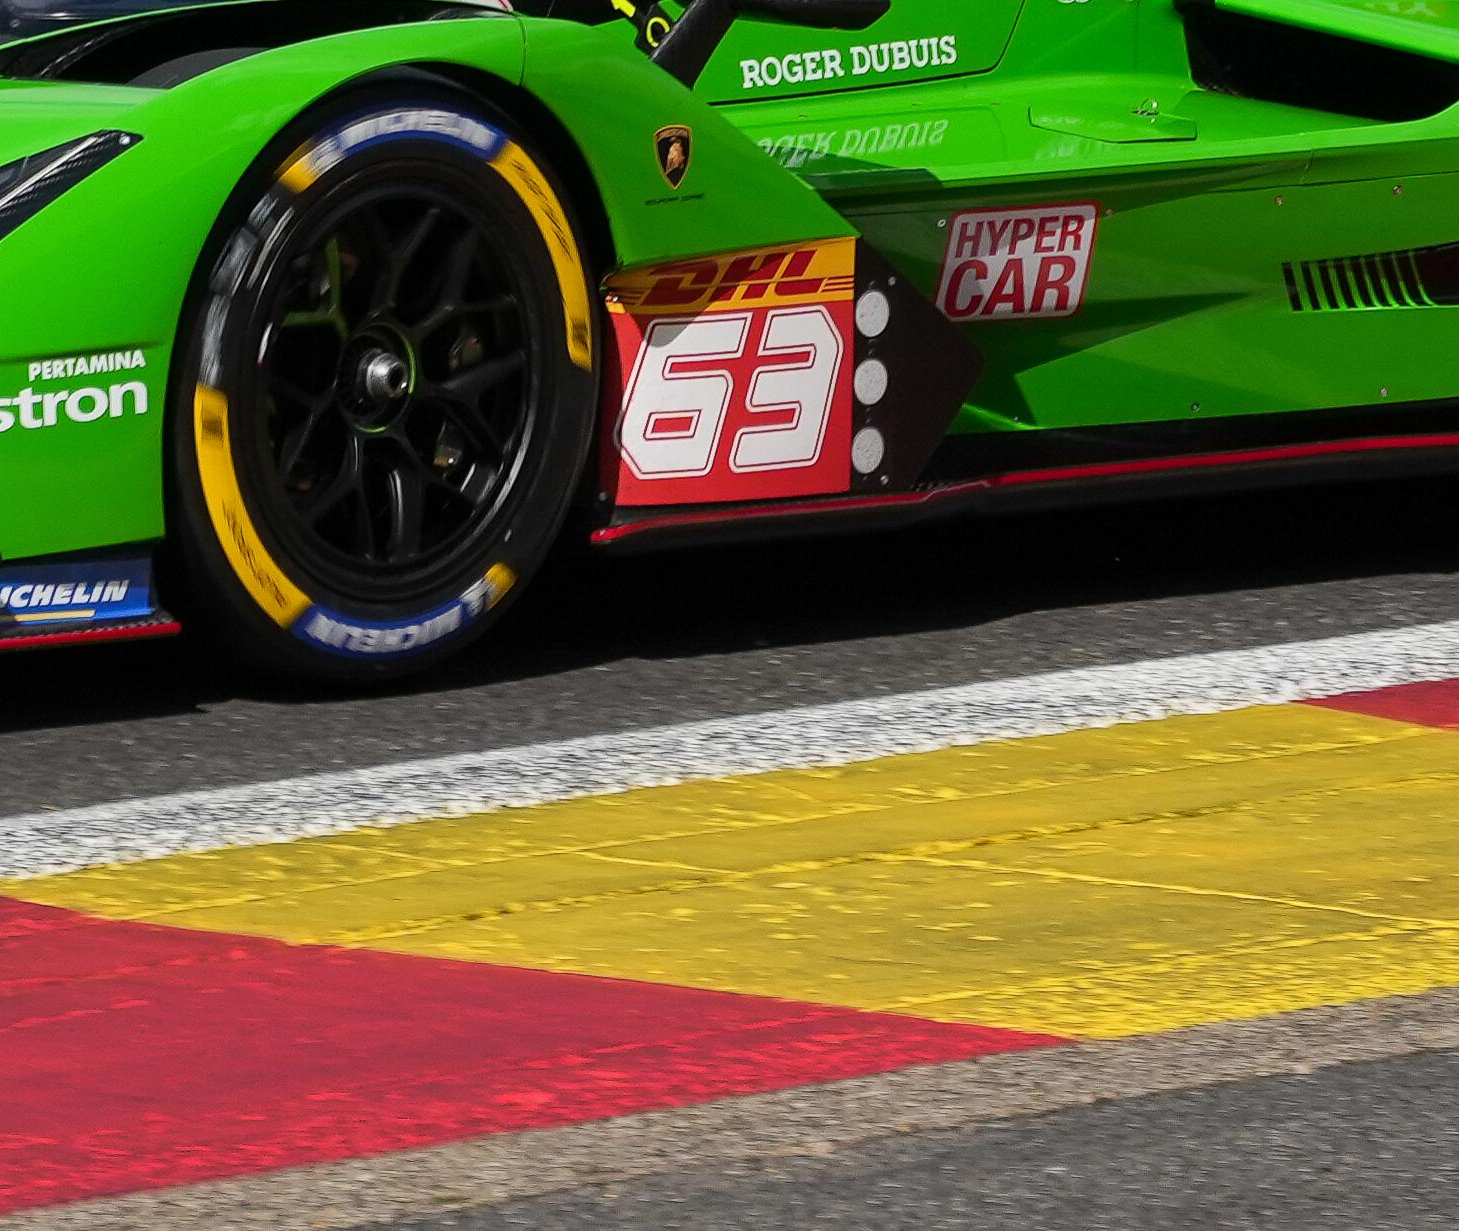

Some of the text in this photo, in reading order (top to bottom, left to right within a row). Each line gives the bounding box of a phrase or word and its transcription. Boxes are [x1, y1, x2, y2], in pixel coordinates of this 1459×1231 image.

[740, 35, 957, 89] ROGER DUBUIS
[954, 213, 1086, 259] HYPER
[642, 249, 827, 306] DHL
[944, 254, 1077, 318] CAR
[28, 349, 147, 381] PERTAMINA
[613, 304, 844, 481] 63
